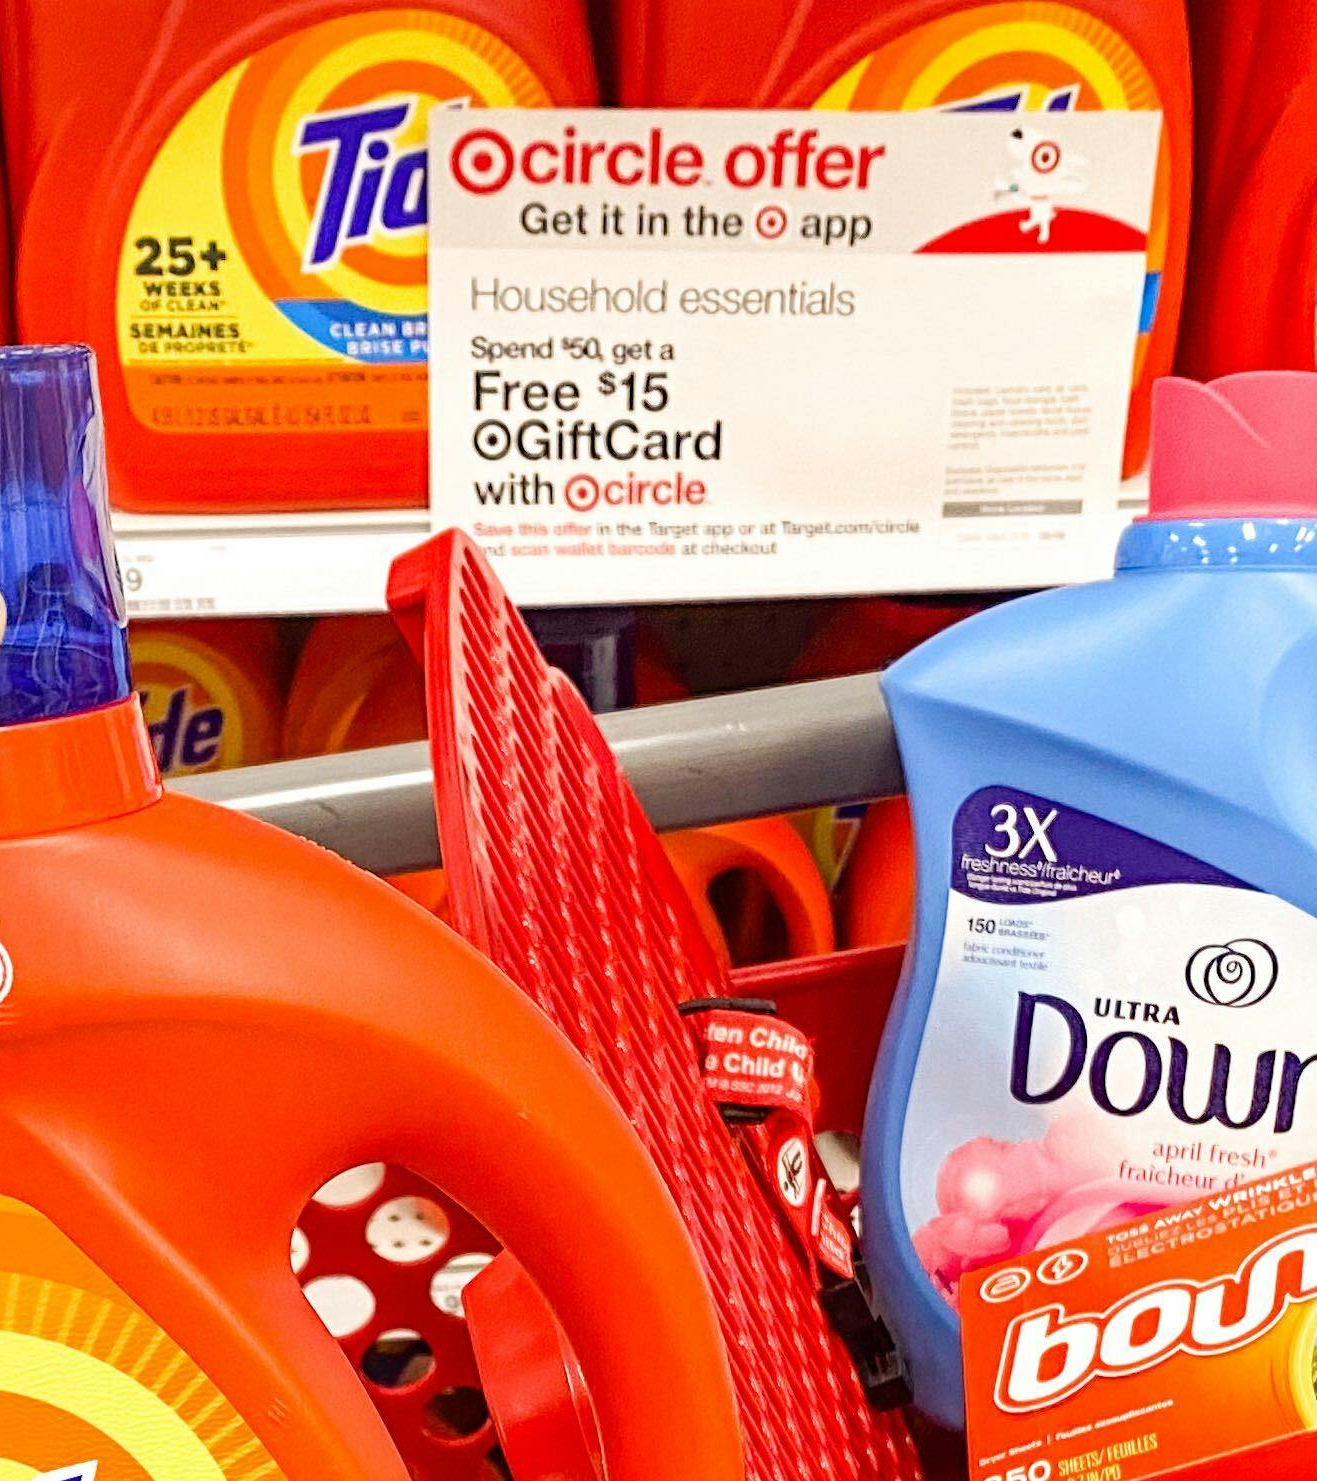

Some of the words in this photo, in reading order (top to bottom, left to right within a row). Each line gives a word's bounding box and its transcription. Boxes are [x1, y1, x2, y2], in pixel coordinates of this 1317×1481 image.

[724, 128, 885, 189] offer
[519, 202, 588, 236] Get
[601, 203, 624, 236] it
[637, 203, 669, 236] in
[685, 206, 743, 236] the
[800, 212, 872, 246] app
[135, 236, 226, 275] 25+
[144, 281, 220, 297] WEEKS
[471, 277, 667, 312] Household
[679, 281, 855, 317] essentials
[130, 323, 239, 339] SEMAINES
[329, 322, 396, 337] CLEAN
[346, 341, 402, 355] BRISE
[471, 336, 553, 363] Spend
[613, 341, 652, 364] get
[660, 343, 674, 360] a
[473, 371, 580, 411] Free
[598, 372, 668, 412] $15
[516, 419, 722, 461] GiftCard
[473, 474, 554, 504] with
[604, 472, 707, 504] circle
[473, 522, 513, 537] Save
[518, 522, 548, 536] this
[553, 522, 591, 536] offer
[598, 522, 611, 535] in
[616, 522, 641, 535] the
[649, 522, 698, 537] Target
[704, 524, 733, 537] app
[739, 524, 755, 535] or
[761, 523, 776, 535] at
[782, 521, 920, 537] Target.com/circle
[984, 803, 1059, 863] 3X
[967, 918, 995, 934] 150
[1094, 998, 1180, 1026] ULTRA
[723, 1053, 785, 1079] Child
[1152, 1141, 1203, 1168] april
[1209, 1143, 1269, 1168] fresh
[1118, 1160, 1215, 1189] fraîcheur
[1223, 1196, 1273, 1219] PLIS
[1278, 1185, 1303, 1202] ET
[1106, 1221, 1150, 1244] TOSS
[1155, 1204, 1203, 1229] AWAY
[1107, 1433, 1158, 1463] FEUILLES
